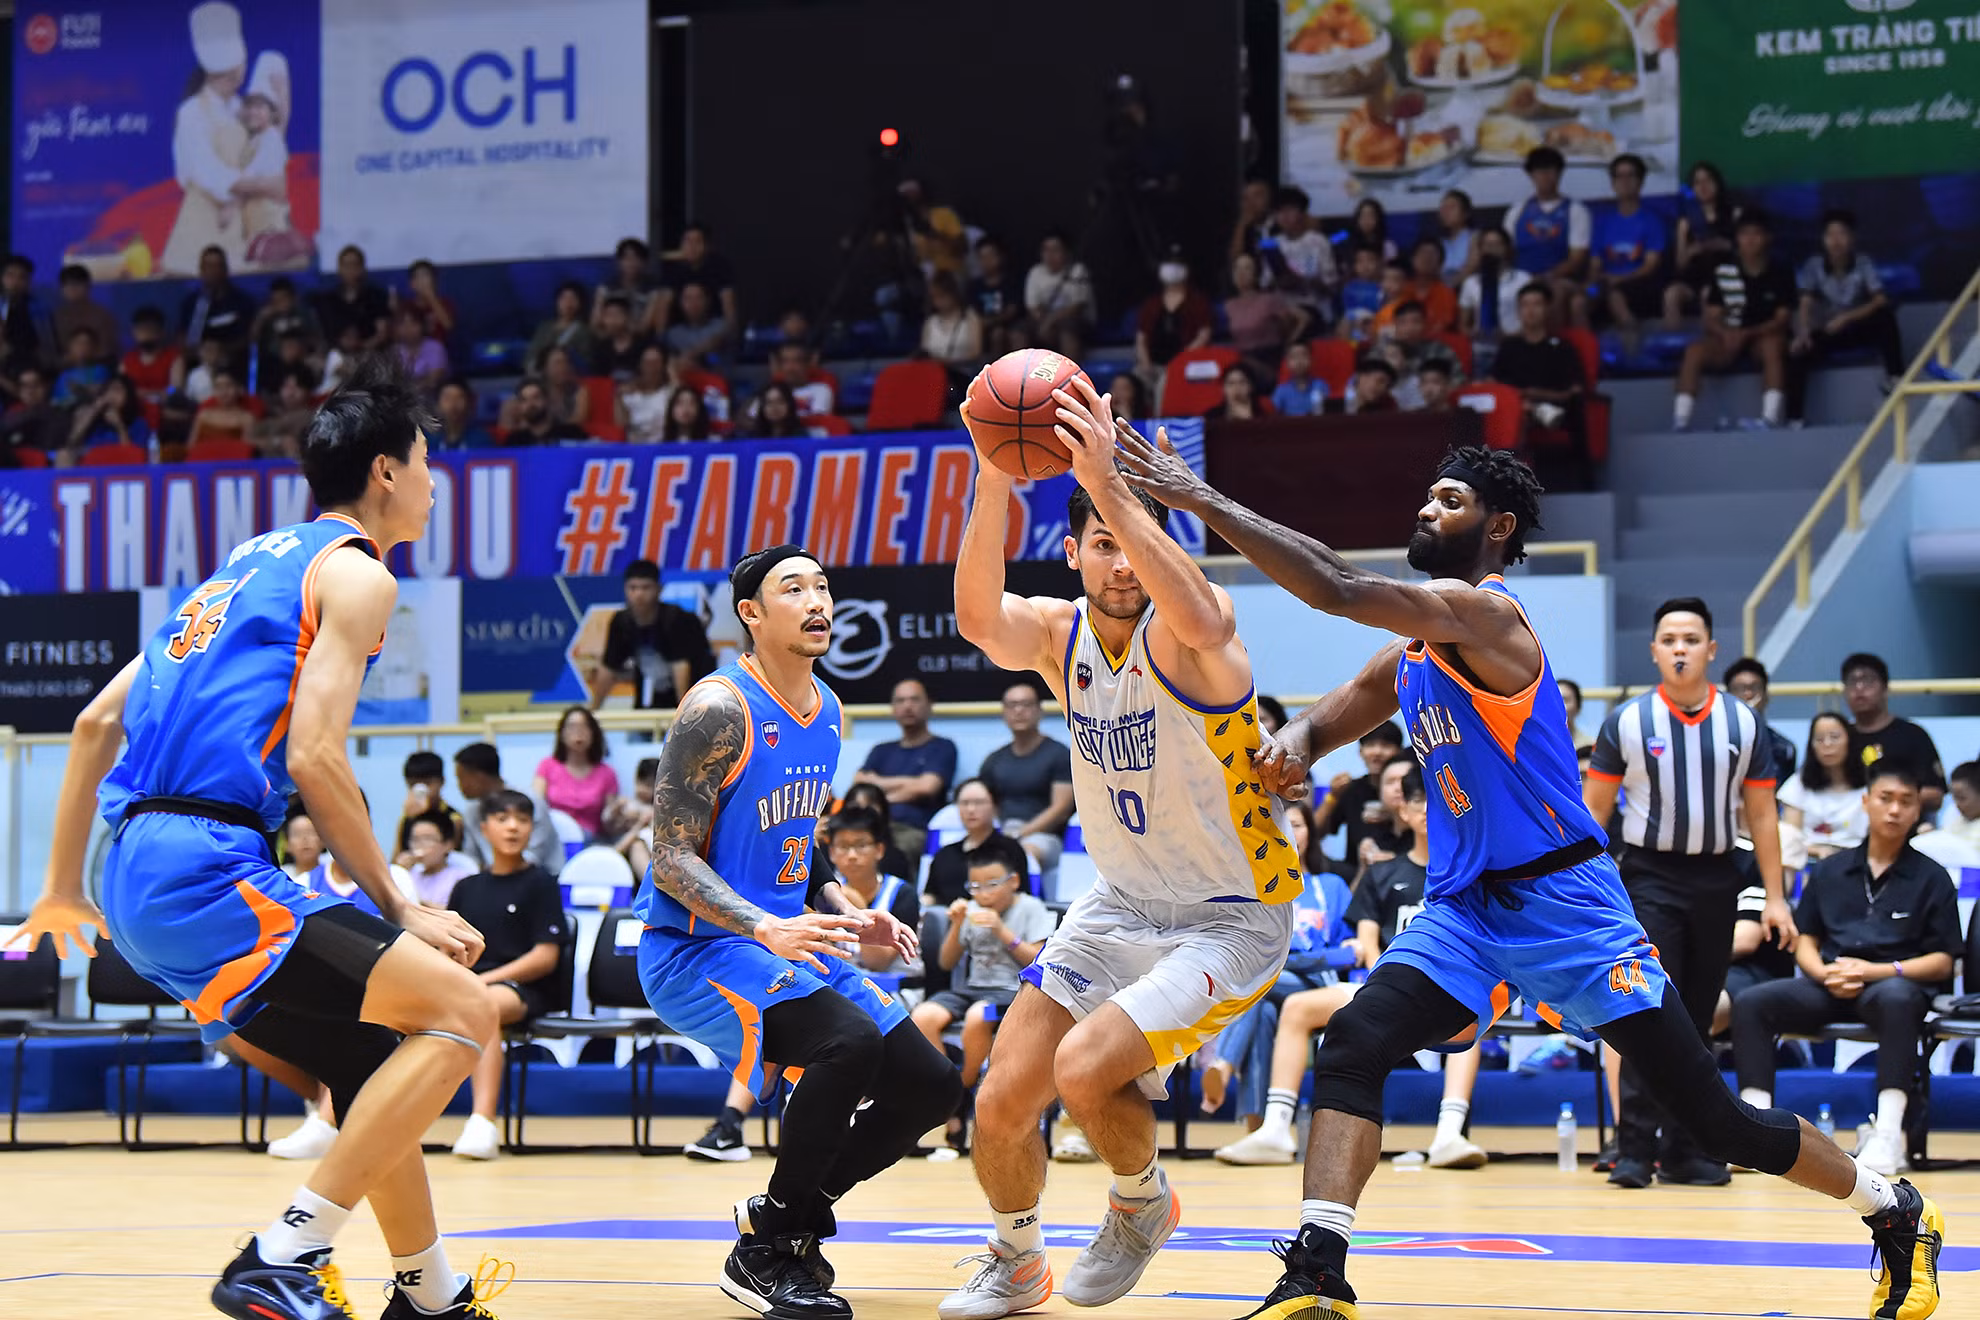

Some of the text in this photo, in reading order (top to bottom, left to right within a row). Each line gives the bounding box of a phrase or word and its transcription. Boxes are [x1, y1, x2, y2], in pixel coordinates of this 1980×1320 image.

[1755, 28, 1822, 57] KEM
[1944, 13, 1980, 43] TI
[1824, 52, 1893, 75] SINCE
[380, 44, 575, 134] OCH
[355, 136, 610, 174] ONE CAPITAL HOSPITALITY
[408, 458, 518, 581] OU
[899, 613, 958, 640] ELIT
[5, 640, 114, 666] FITNESS
[785, 764, 827, 775] HANOI
[757, 778, 833, 833] BUFFALO
[1435, 763, 1473, 819] 44
[1608, 957, 1652, 996] 44
[395, 1268, 423, 1286] KE
